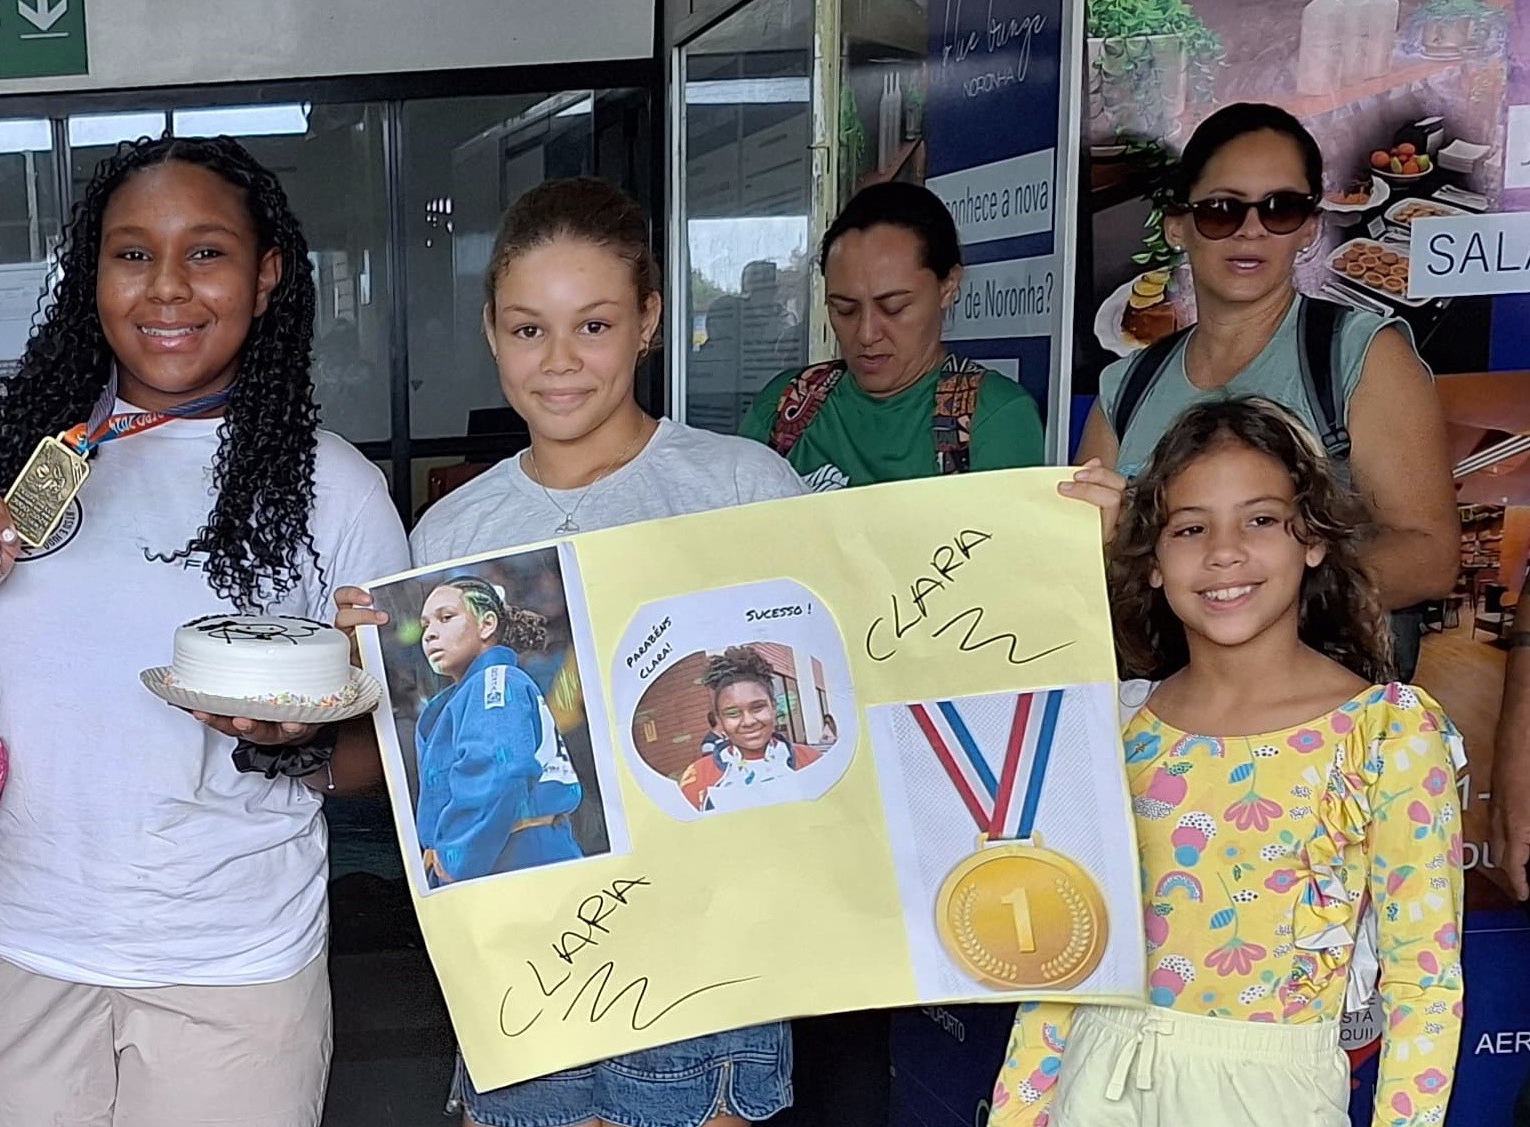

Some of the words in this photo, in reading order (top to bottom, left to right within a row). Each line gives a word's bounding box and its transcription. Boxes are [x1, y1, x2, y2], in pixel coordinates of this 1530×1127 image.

[1001, 189, 1010, 217] a
[1014, 181, 1049, 215] nova
[965, 282, 981, 319] de
[985, 272, 1053, 318] Noronha?
[746, 605, 803, 622] SUCESSO
[866, 530, 993, 661] CLARA
[626, 616, 672, 667] PARABÉNS
[640, 643, 673, 679] CLARA!
[1001, 887, 1036, 953] 1
[500, 876, 652, 1037] CLARA
